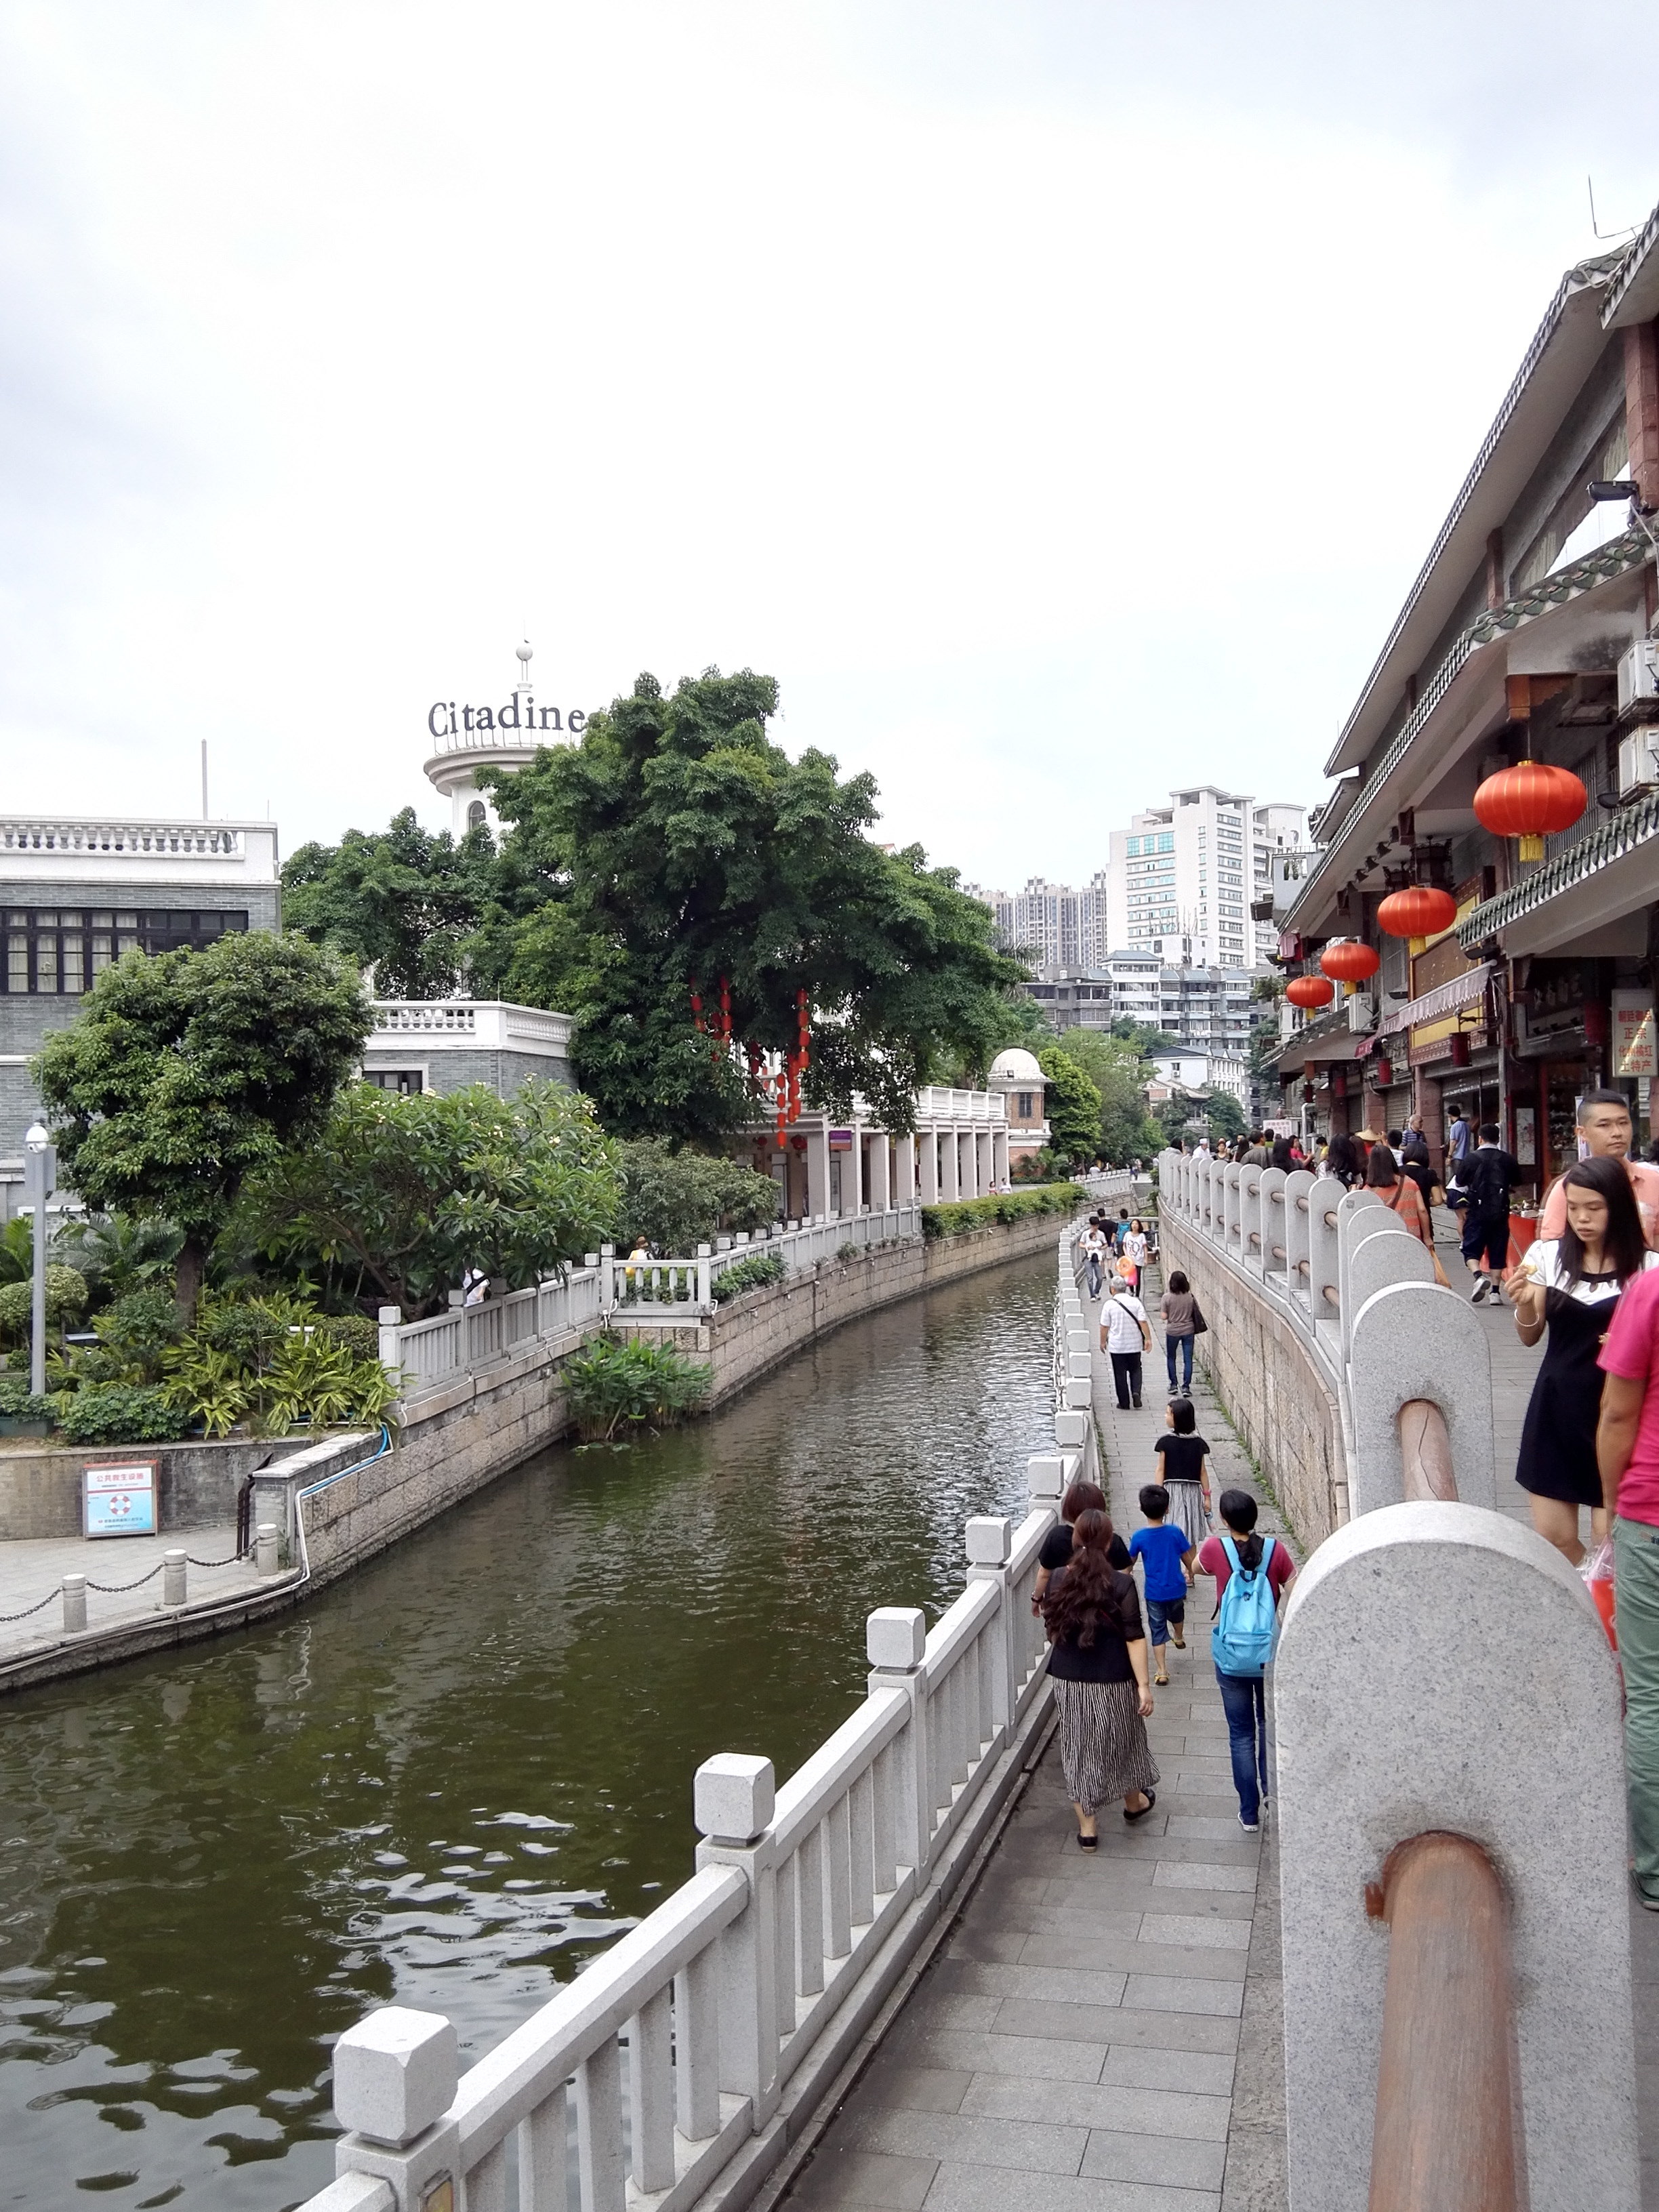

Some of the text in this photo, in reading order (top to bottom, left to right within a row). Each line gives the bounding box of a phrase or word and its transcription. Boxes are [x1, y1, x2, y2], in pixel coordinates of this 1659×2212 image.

[1624, 1027, 1647, 1040] 正宗
[1620, 1060, 1652, 1072] 土特产
